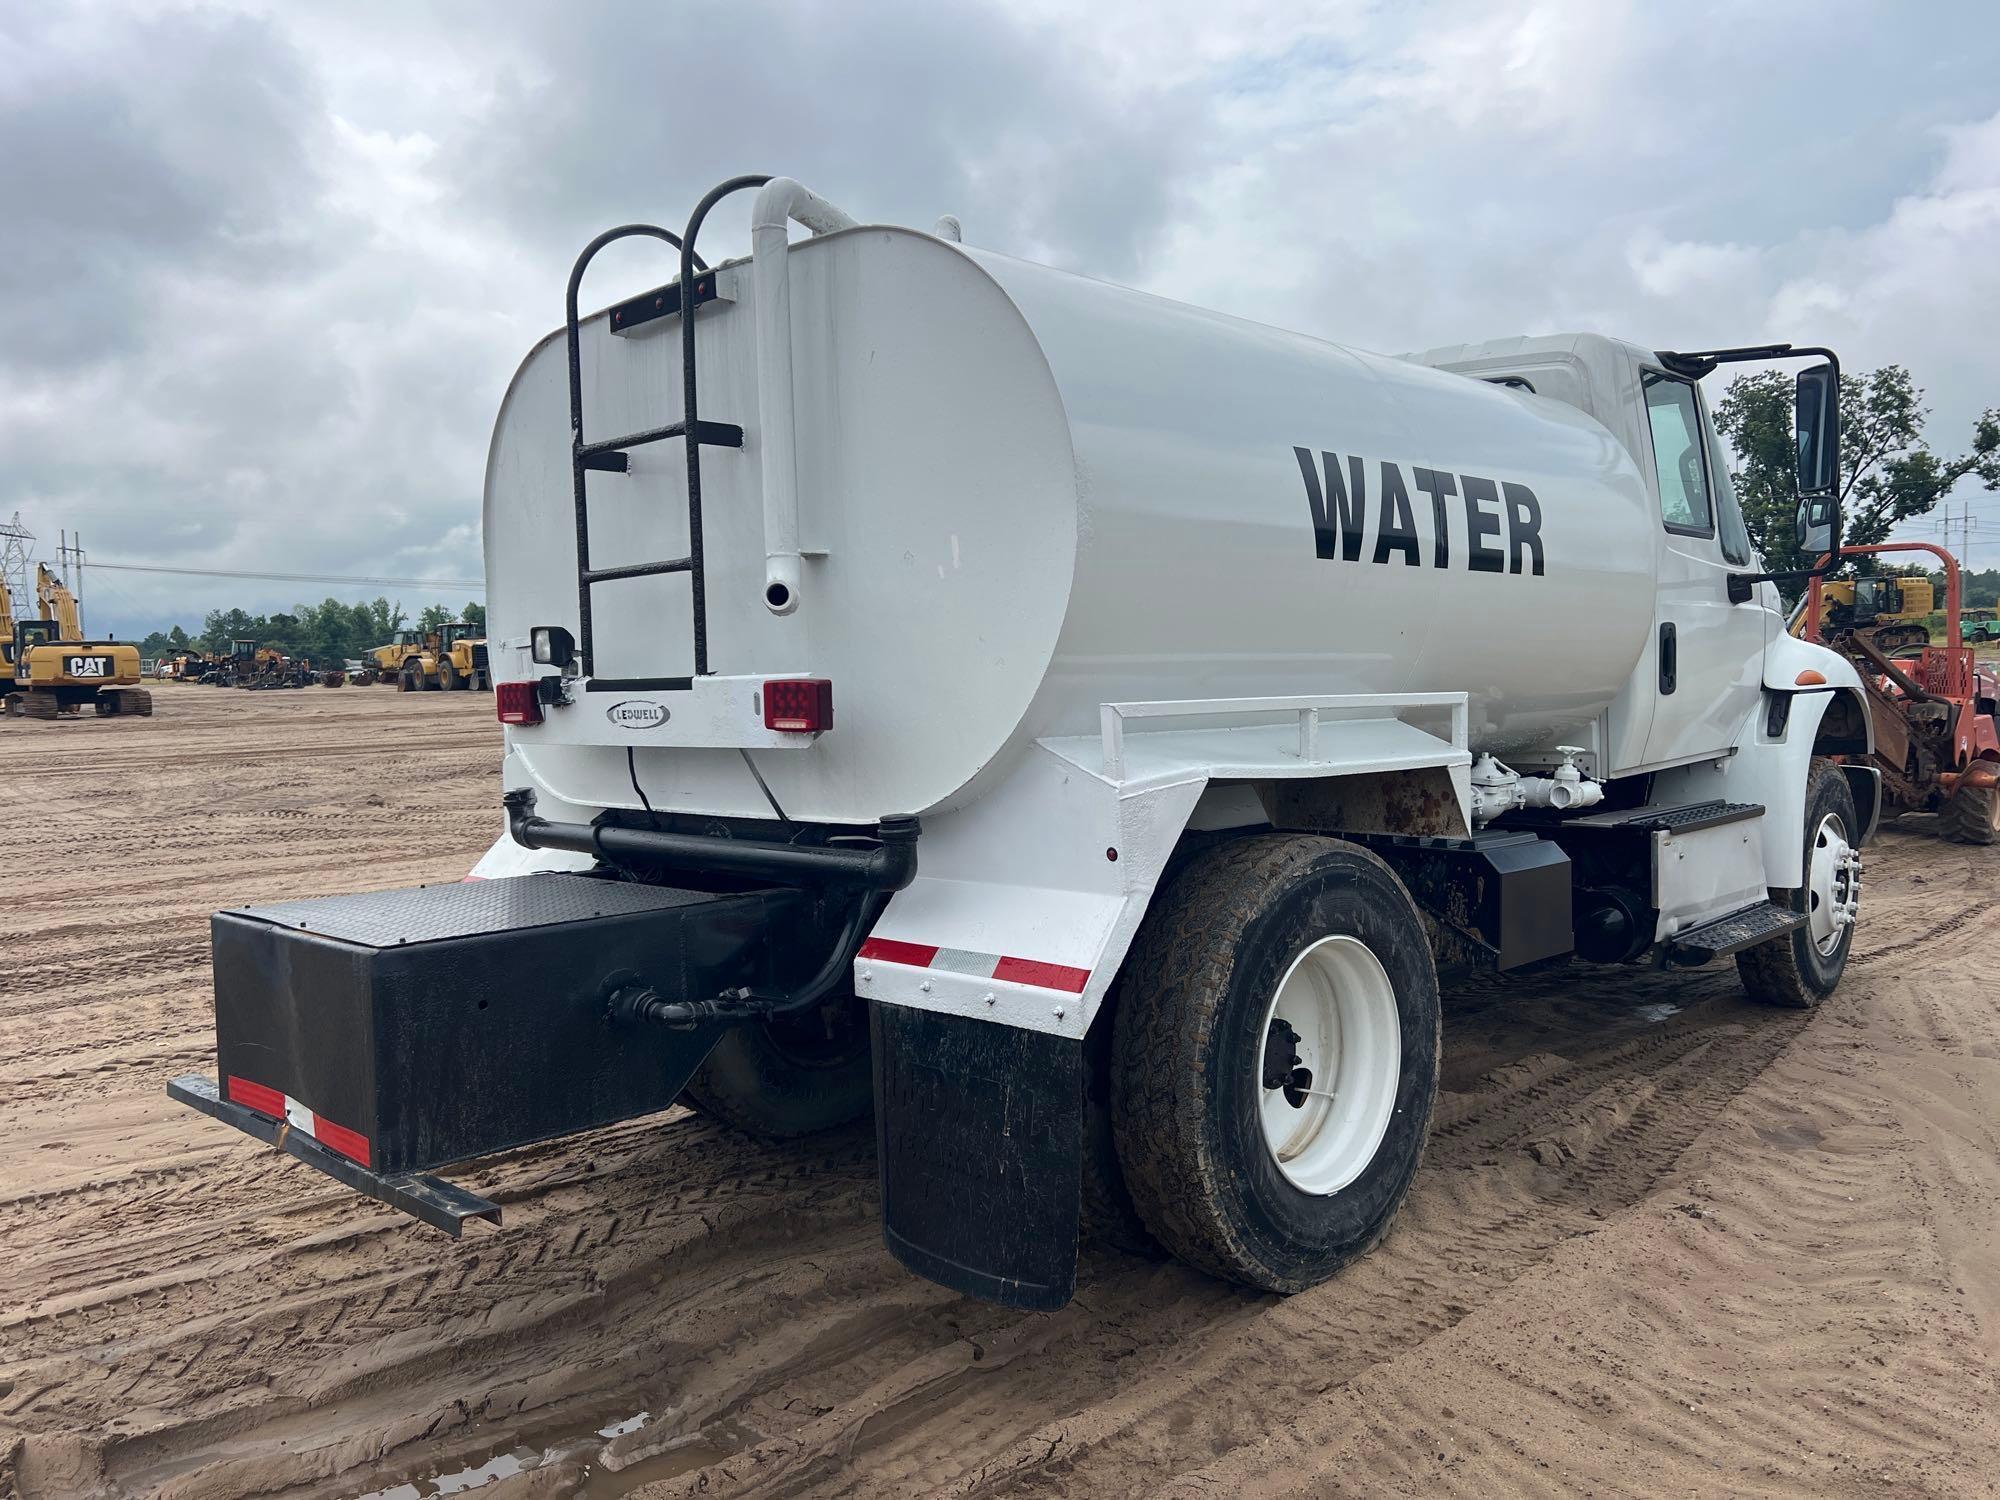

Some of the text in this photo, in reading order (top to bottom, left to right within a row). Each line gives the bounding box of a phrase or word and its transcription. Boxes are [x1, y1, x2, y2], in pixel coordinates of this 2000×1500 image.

[1293, 446, 1545, 577] WATER
[70, 657, 106, 677] CAT
[616, 709, 659, 720] LEDWELL
